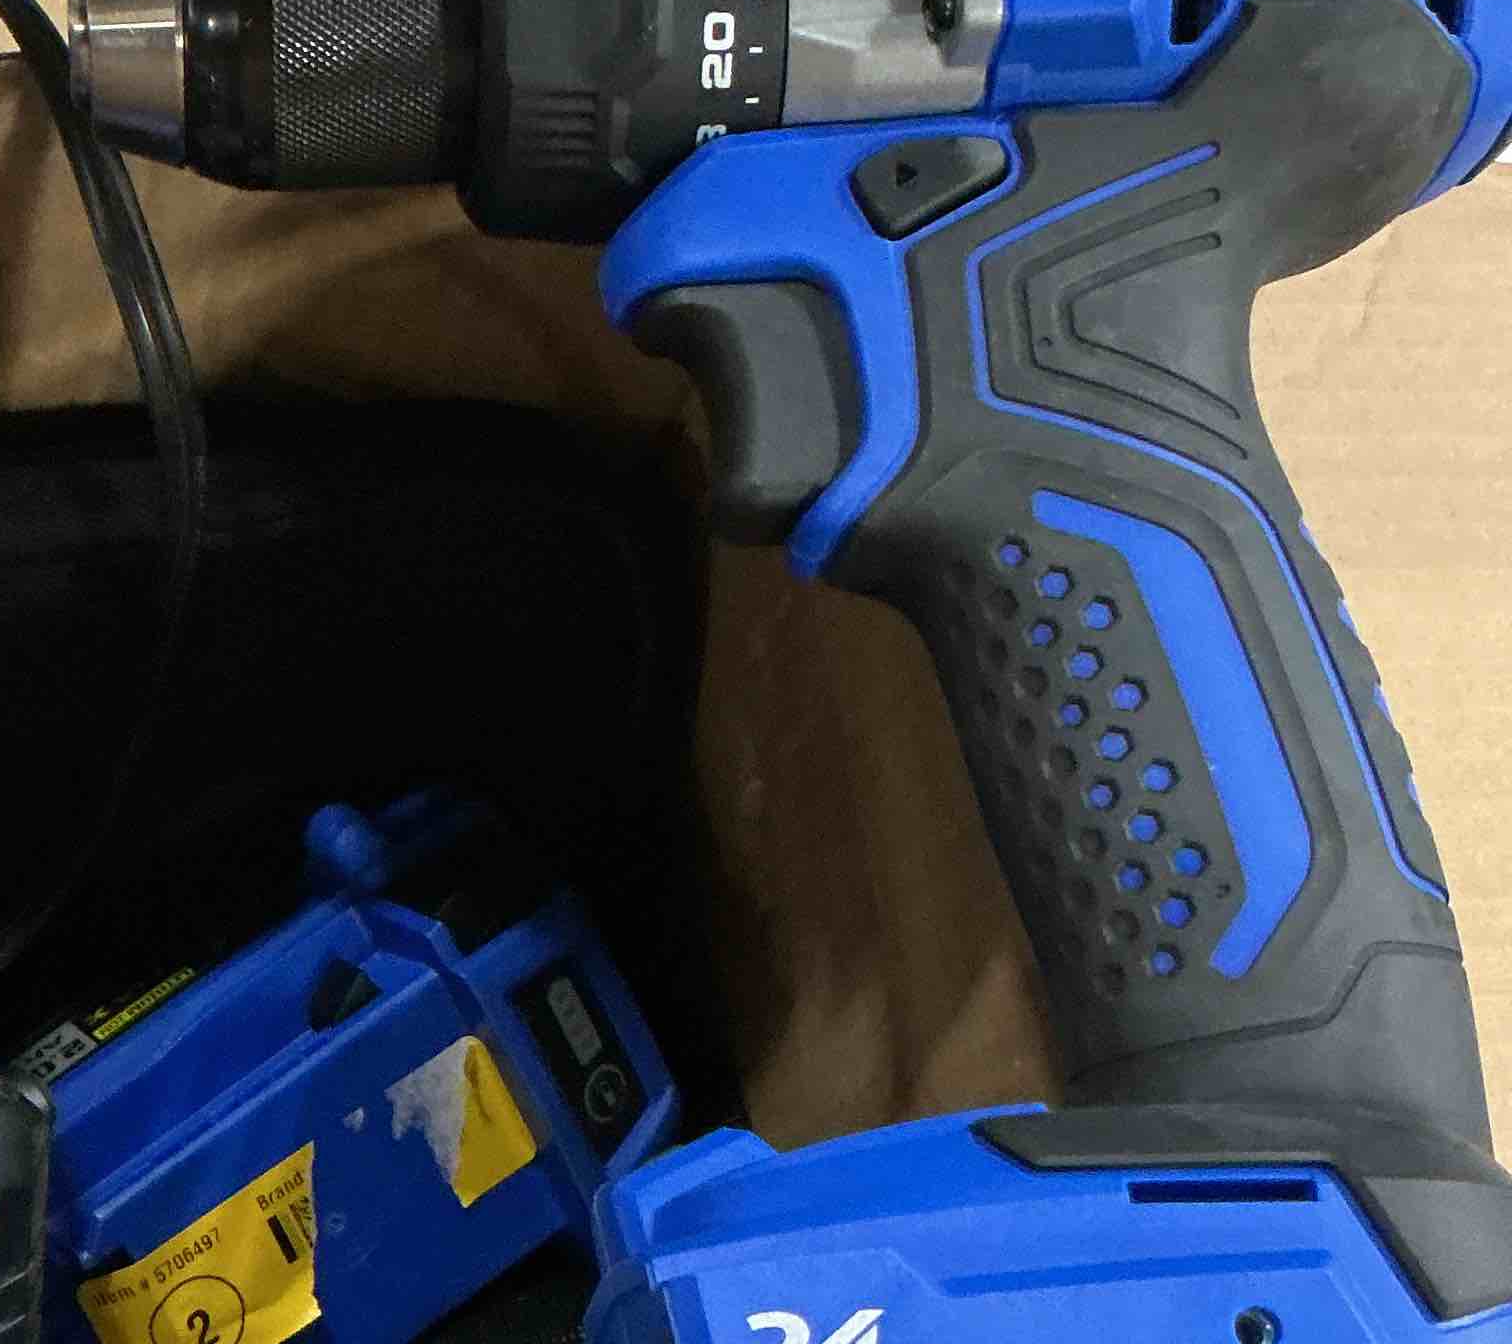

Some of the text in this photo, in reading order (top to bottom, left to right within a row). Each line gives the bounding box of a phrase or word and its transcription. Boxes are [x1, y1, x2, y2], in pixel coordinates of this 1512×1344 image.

[701, 11, 736, 90] 20
[255, 1170, 305, 1211] Brand
[152, 1227, 221, 1285] 5706497
